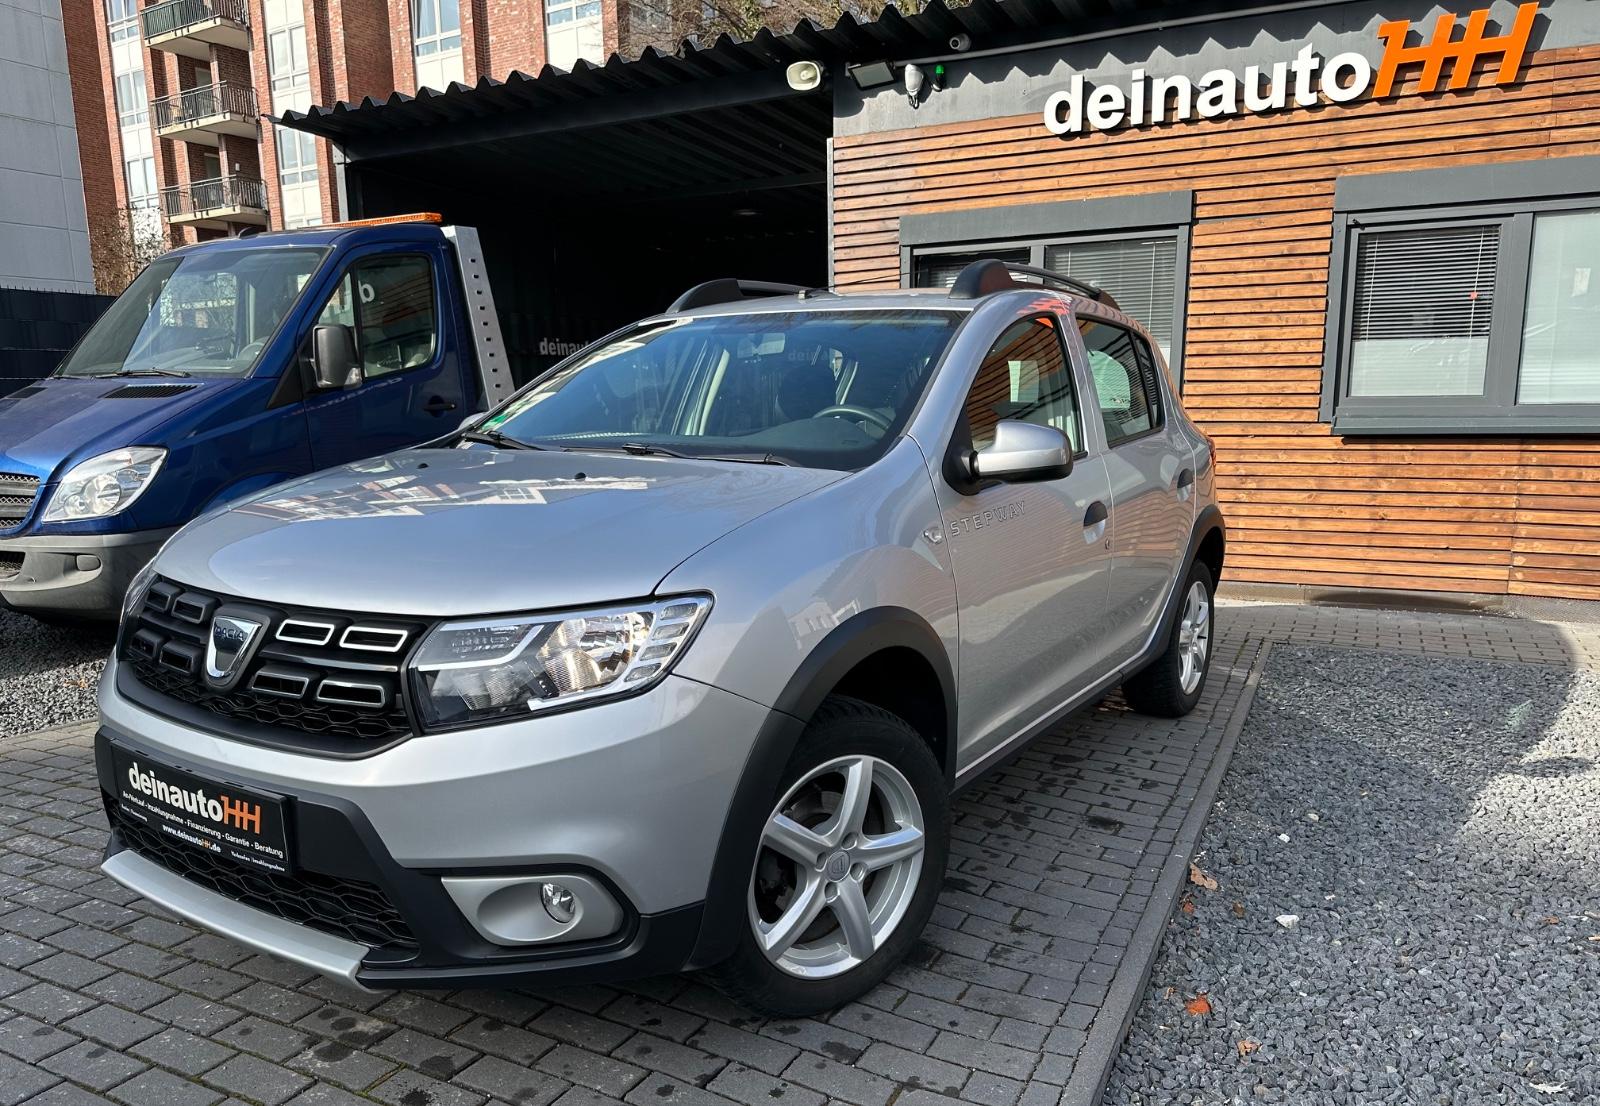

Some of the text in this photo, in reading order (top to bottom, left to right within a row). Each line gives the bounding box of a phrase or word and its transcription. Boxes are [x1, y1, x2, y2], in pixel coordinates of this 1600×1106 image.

[949, 500, 1026, 537] STEPWAY
[128, 761, 261, 834] deinautoHH
[187, 819, 221, 839] Finanzierung
[225, 832, 250, 847] Garantie
[254, 841, 283, 858] Beratung
